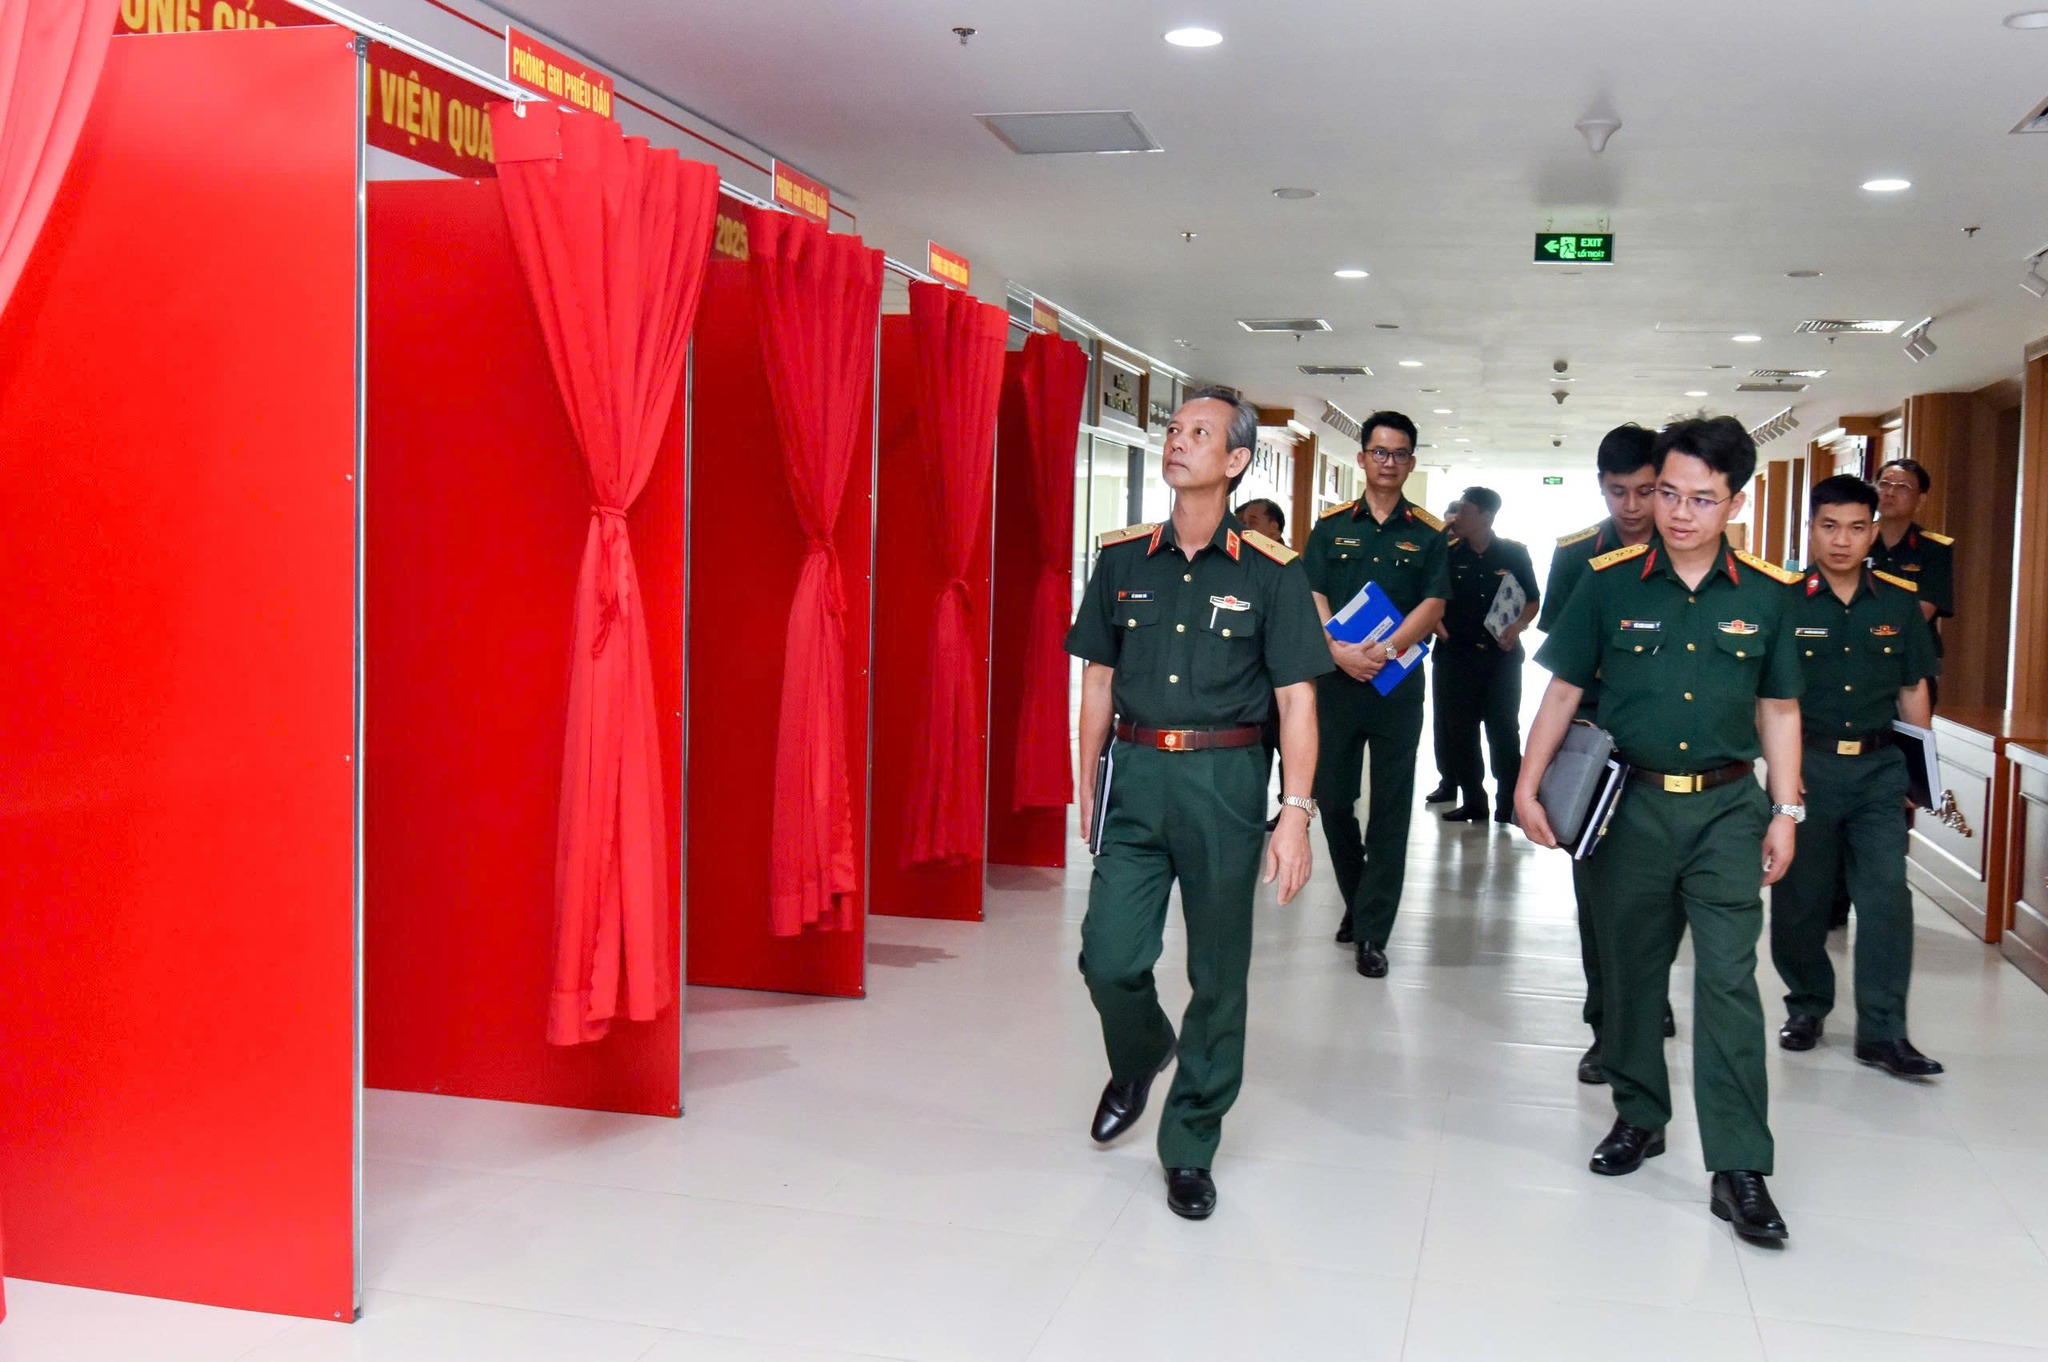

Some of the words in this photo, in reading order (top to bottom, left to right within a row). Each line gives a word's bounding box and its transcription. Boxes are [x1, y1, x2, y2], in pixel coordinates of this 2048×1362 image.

[379, 68, 441, 146] VIỆN
[513, 46, 546, 88] PHÒNG
[547, 63, 563, 97] GHI
[564, 71, 591, 109] PHIẾU
[592, 80, 610, 118] BẦU
[715, 213, 750, 262] 2025
[1580, 238, 1603, 247] EXIT
